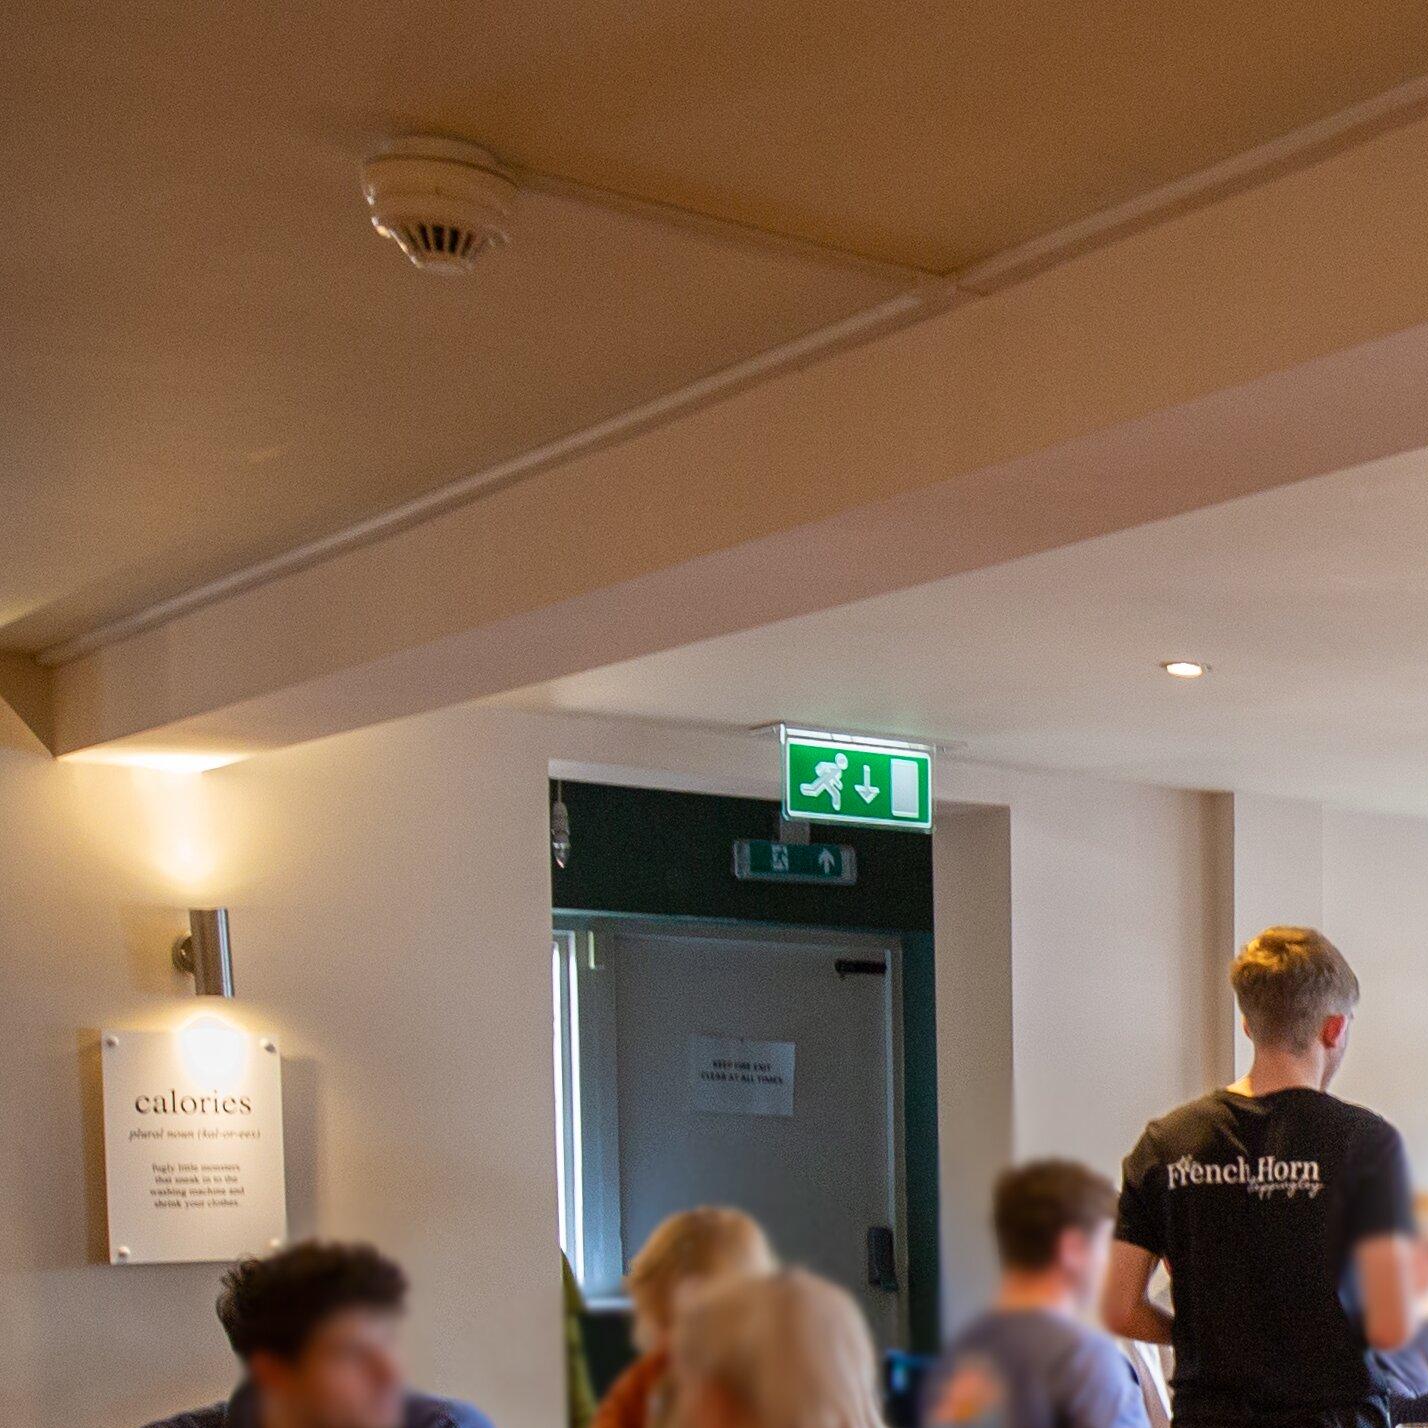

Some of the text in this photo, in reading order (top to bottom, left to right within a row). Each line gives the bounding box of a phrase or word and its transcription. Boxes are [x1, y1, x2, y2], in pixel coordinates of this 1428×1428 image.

[134, 1088, 252, 1115] calories
[1167, 1154, 1320, 1190] French Horn
[155, 1175, 172, 1183] that
[175, 1175, 199, 1183] sneak
[225, 1175, 238, 1183] the
[150, 1186, 244, 1197] washing machine and
[154, 1199, 181, 1208] shrink
[184, 1201, 204, 1209] your
